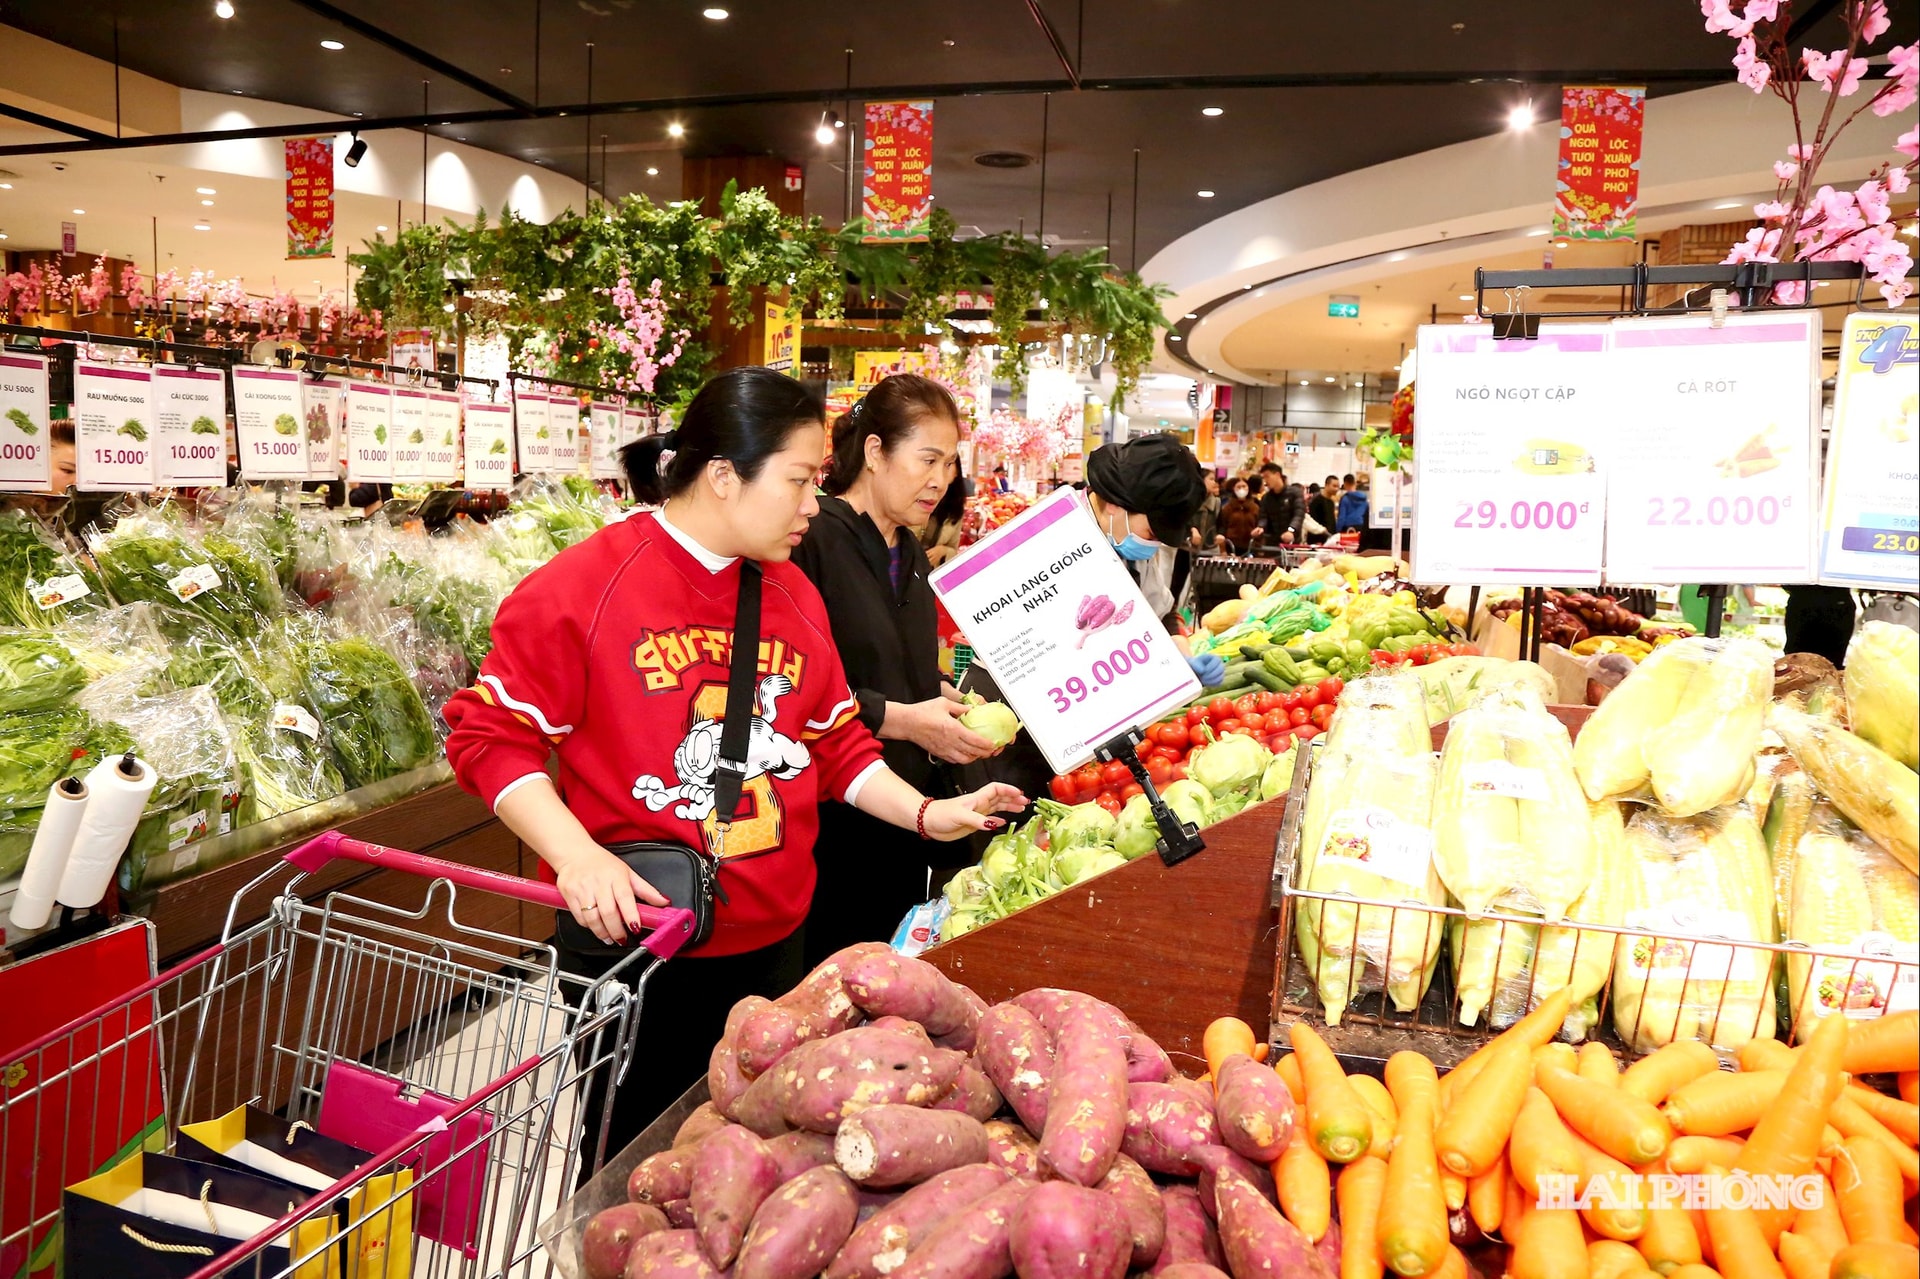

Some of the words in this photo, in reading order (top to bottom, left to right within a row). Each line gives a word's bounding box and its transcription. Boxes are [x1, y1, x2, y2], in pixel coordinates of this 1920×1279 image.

[1569, 138, 1599, 148] NGON
[1609, 138, 1629, 150] LỘC
[873, 148, 897, 157] NGON
[1604, 152, 1632, 164] XUÂN
[901, 160, 924, 170] XUÂN
[1859, 325, 1912, 374] 4
[4, 384, 14, 392] SU
[16, 385, 35, 393] 500G
[1677, 380, 1700, 394] CÀ
[1704, 379, 1737, 394] RỐT
[1455, 385, 1490, 400] NGÔ
[1495, 387, 1540, 404] NGỌT
[1545, 384, 1577, 404] CẶP
[972, 592, 1012, 625] KHOAI
[1013, 569, 1050, 600] LANG
[1049, 541, 1093, 574] GIỐNG
[1022, 583, 1060, 614] NHẬT
[633, 627, 806, 692] garfld
